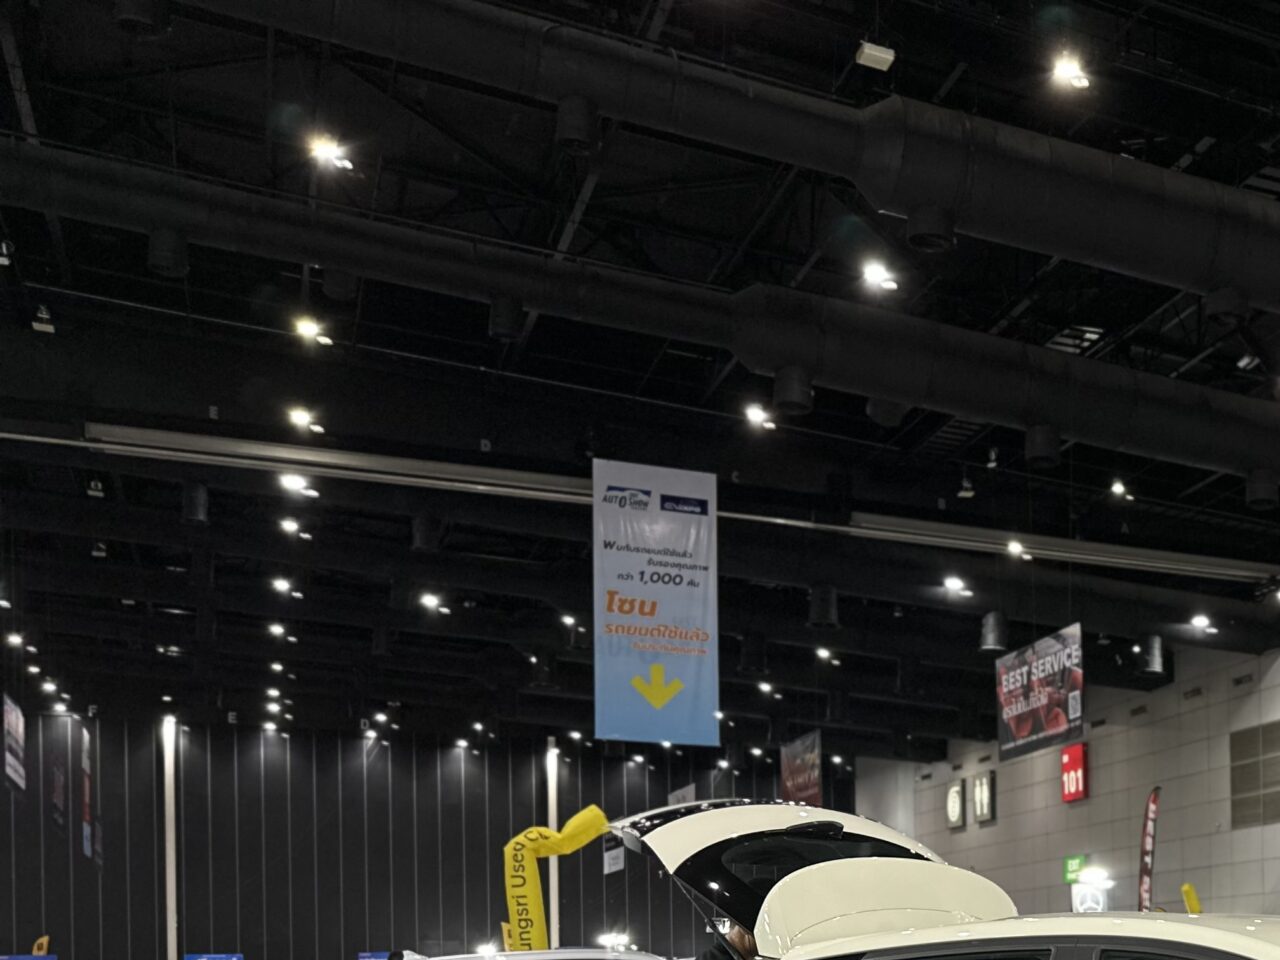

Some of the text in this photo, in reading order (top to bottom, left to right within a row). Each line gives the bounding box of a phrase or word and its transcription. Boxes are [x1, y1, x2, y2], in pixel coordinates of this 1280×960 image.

[638, 570, 683, 587] 1,000
[606, 589, 658, 617] โซน
[605, 623, 710, 642] รถยนต์ใช้แล้ว
[1030, 643, 1081, 681] SERVICE
[1062, 768, 1083, 795] 101
